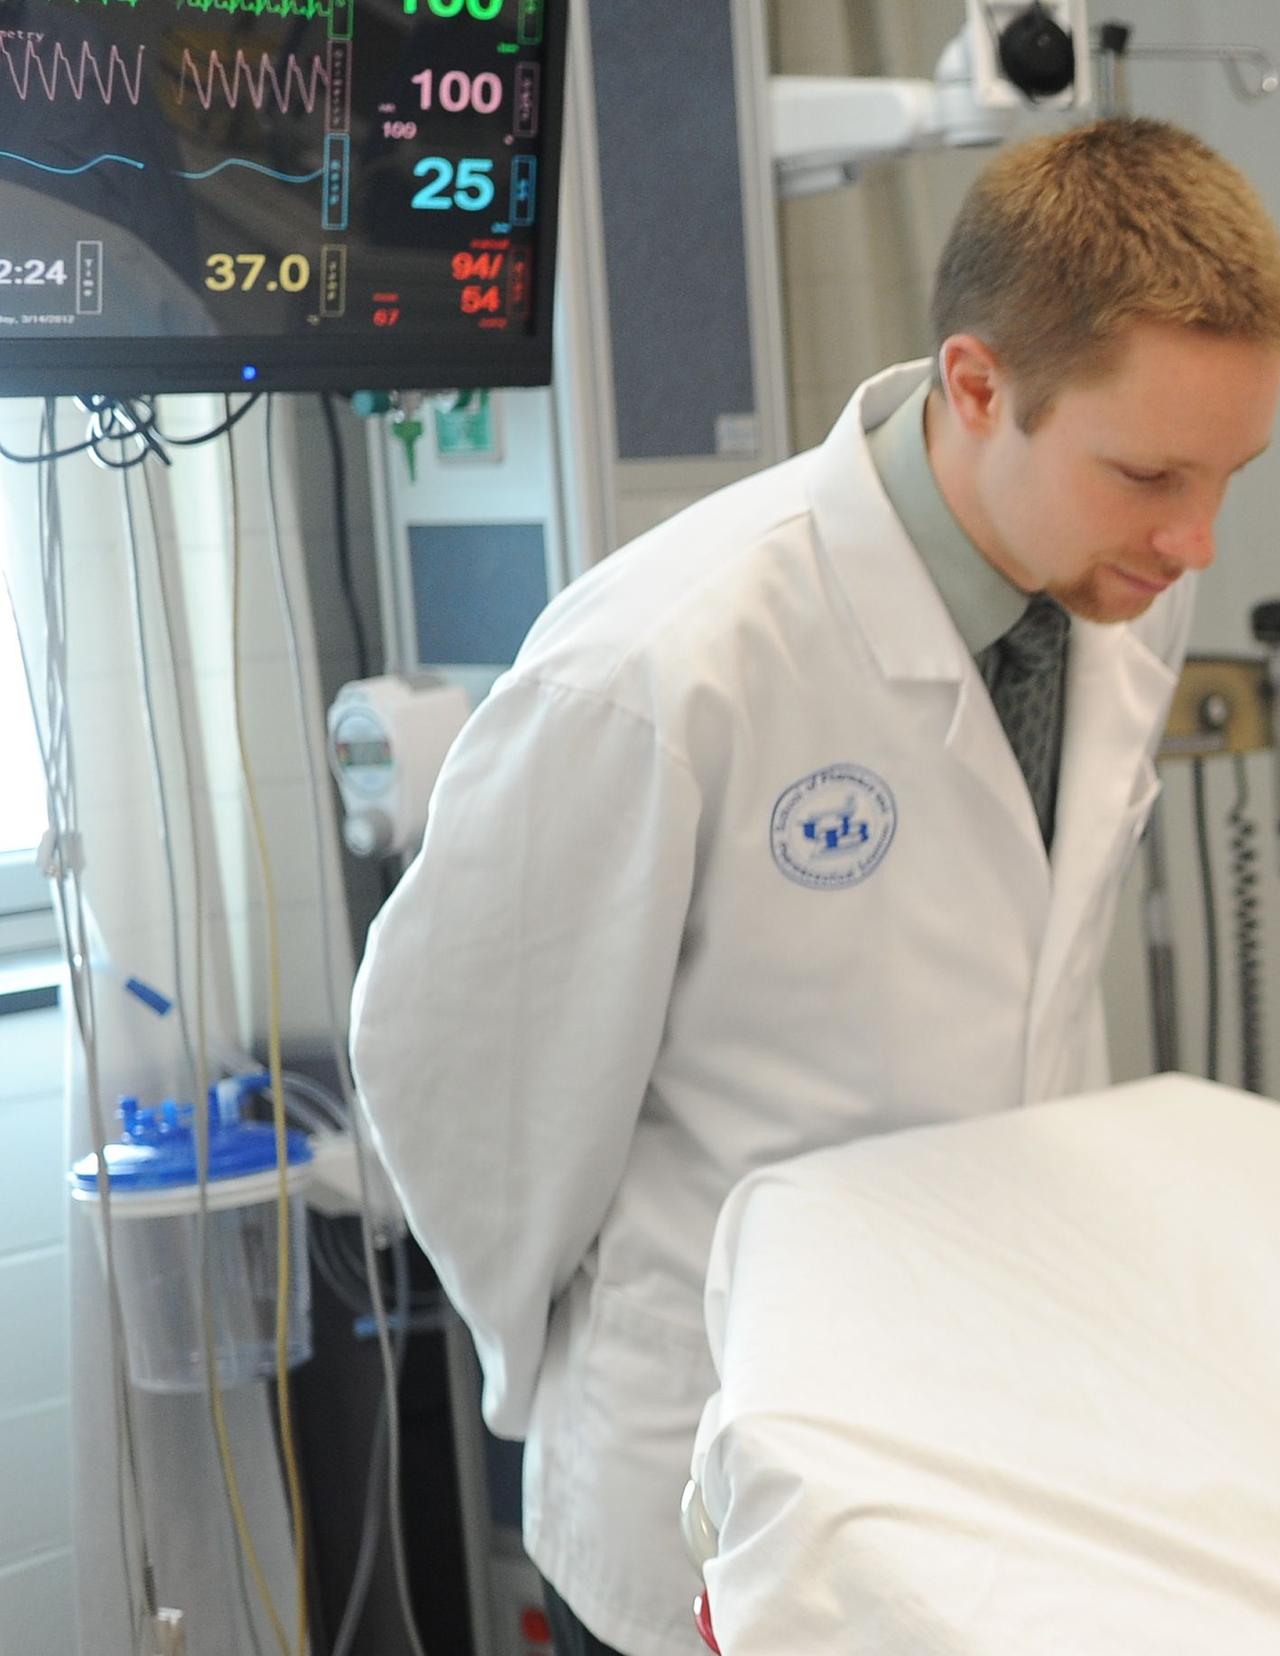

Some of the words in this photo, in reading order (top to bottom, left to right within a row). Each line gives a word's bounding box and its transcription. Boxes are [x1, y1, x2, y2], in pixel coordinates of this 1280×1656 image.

[411, 68, 503, 114] 100
[411, 156, 495, 211] 25
[205, 253, 310, 292] 37.0
